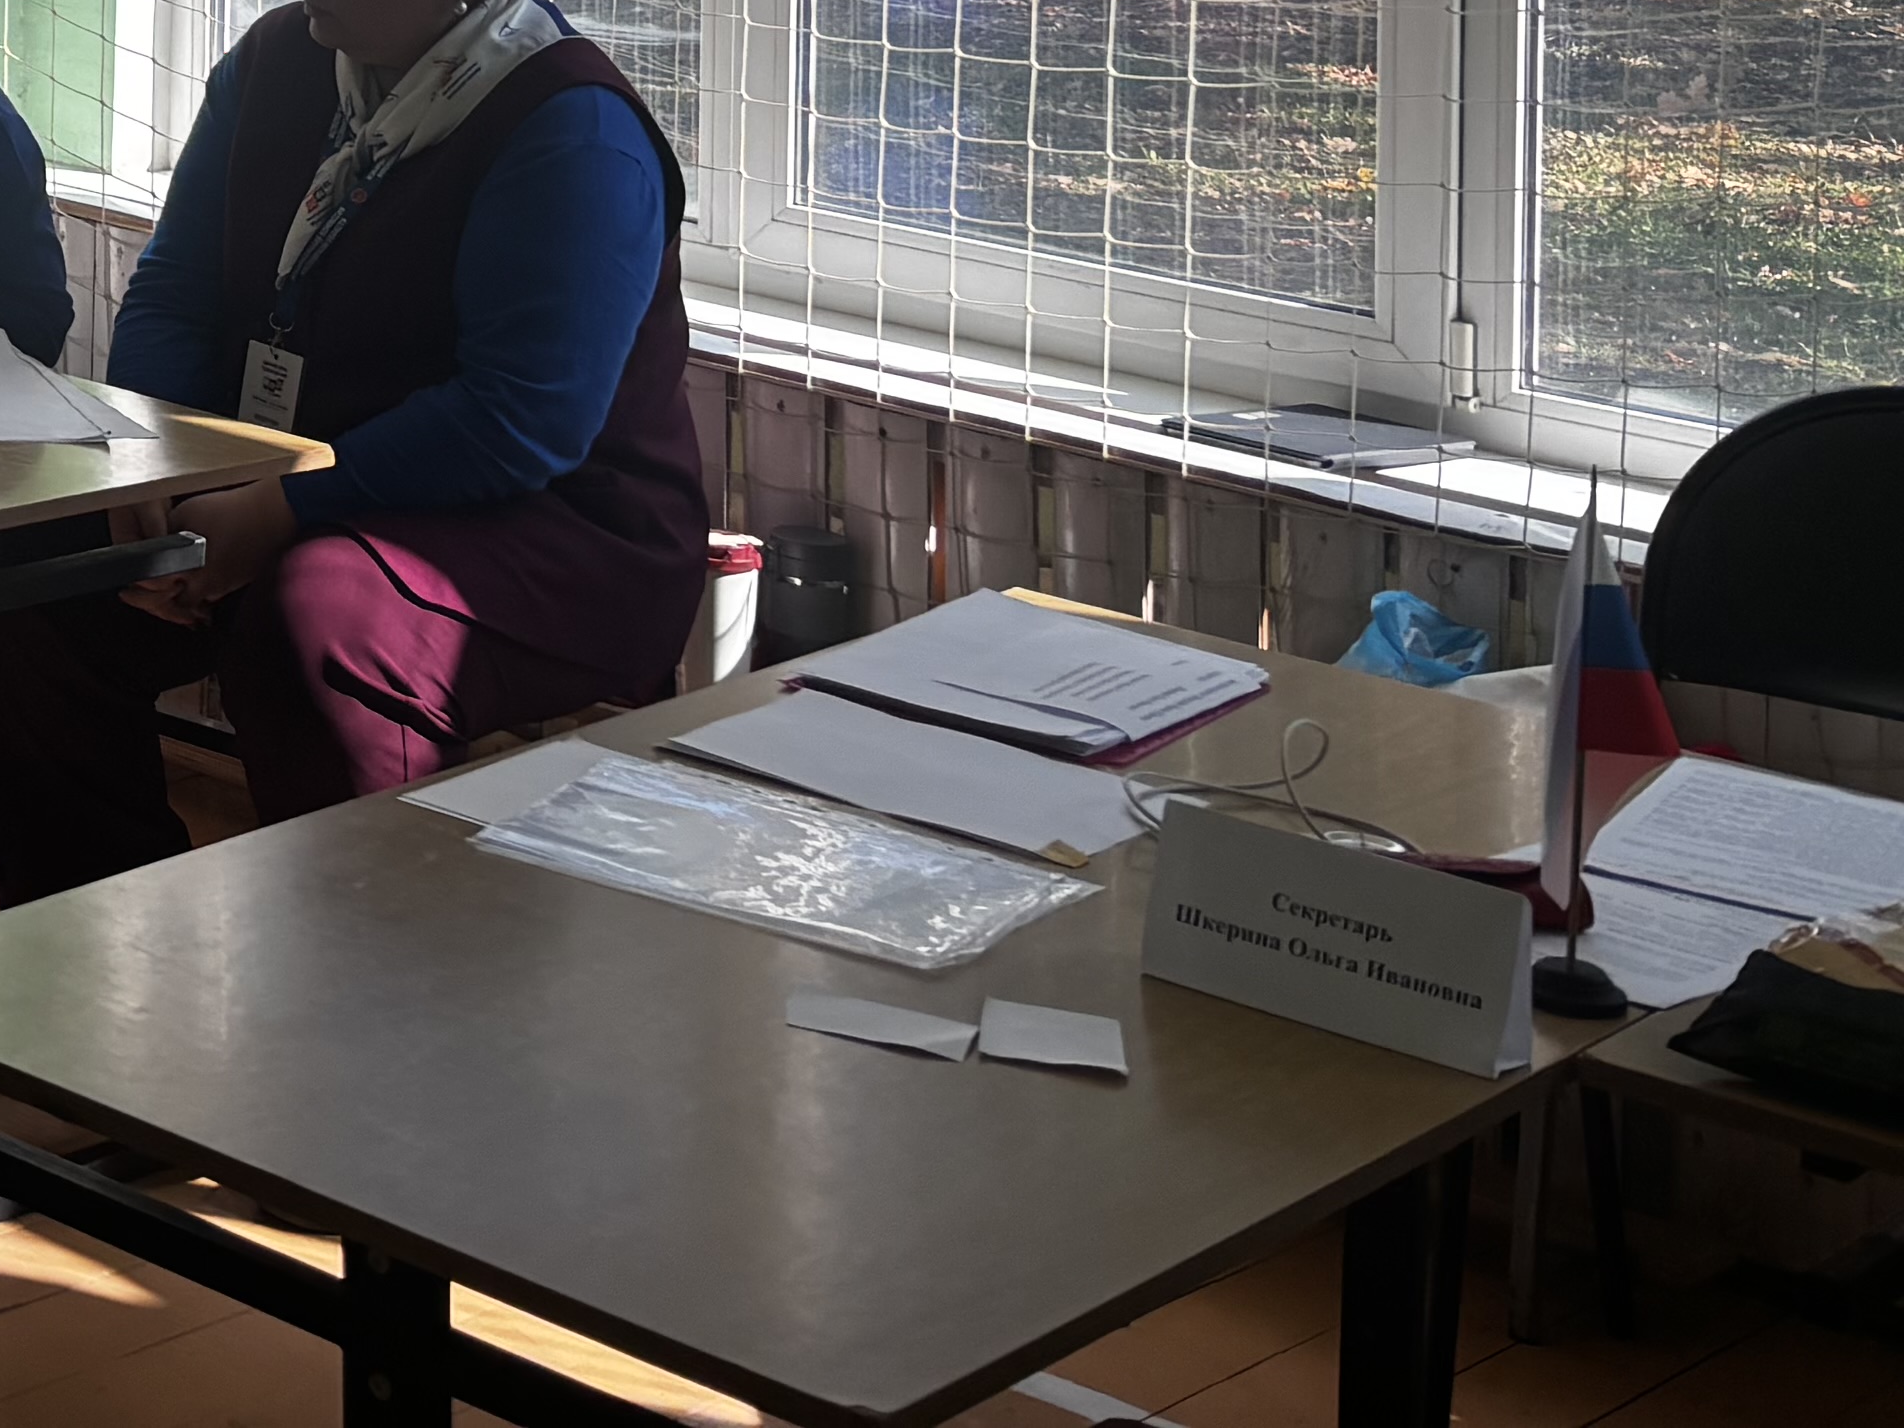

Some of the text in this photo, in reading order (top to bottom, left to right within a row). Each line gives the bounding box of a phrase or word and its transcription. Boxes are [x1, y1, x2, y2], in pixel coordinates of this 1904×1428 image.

[1176, 902, 1483, 1011] Шкерина Ольга Ивановна
[1271, 892, 1393, 943] Секретарь
